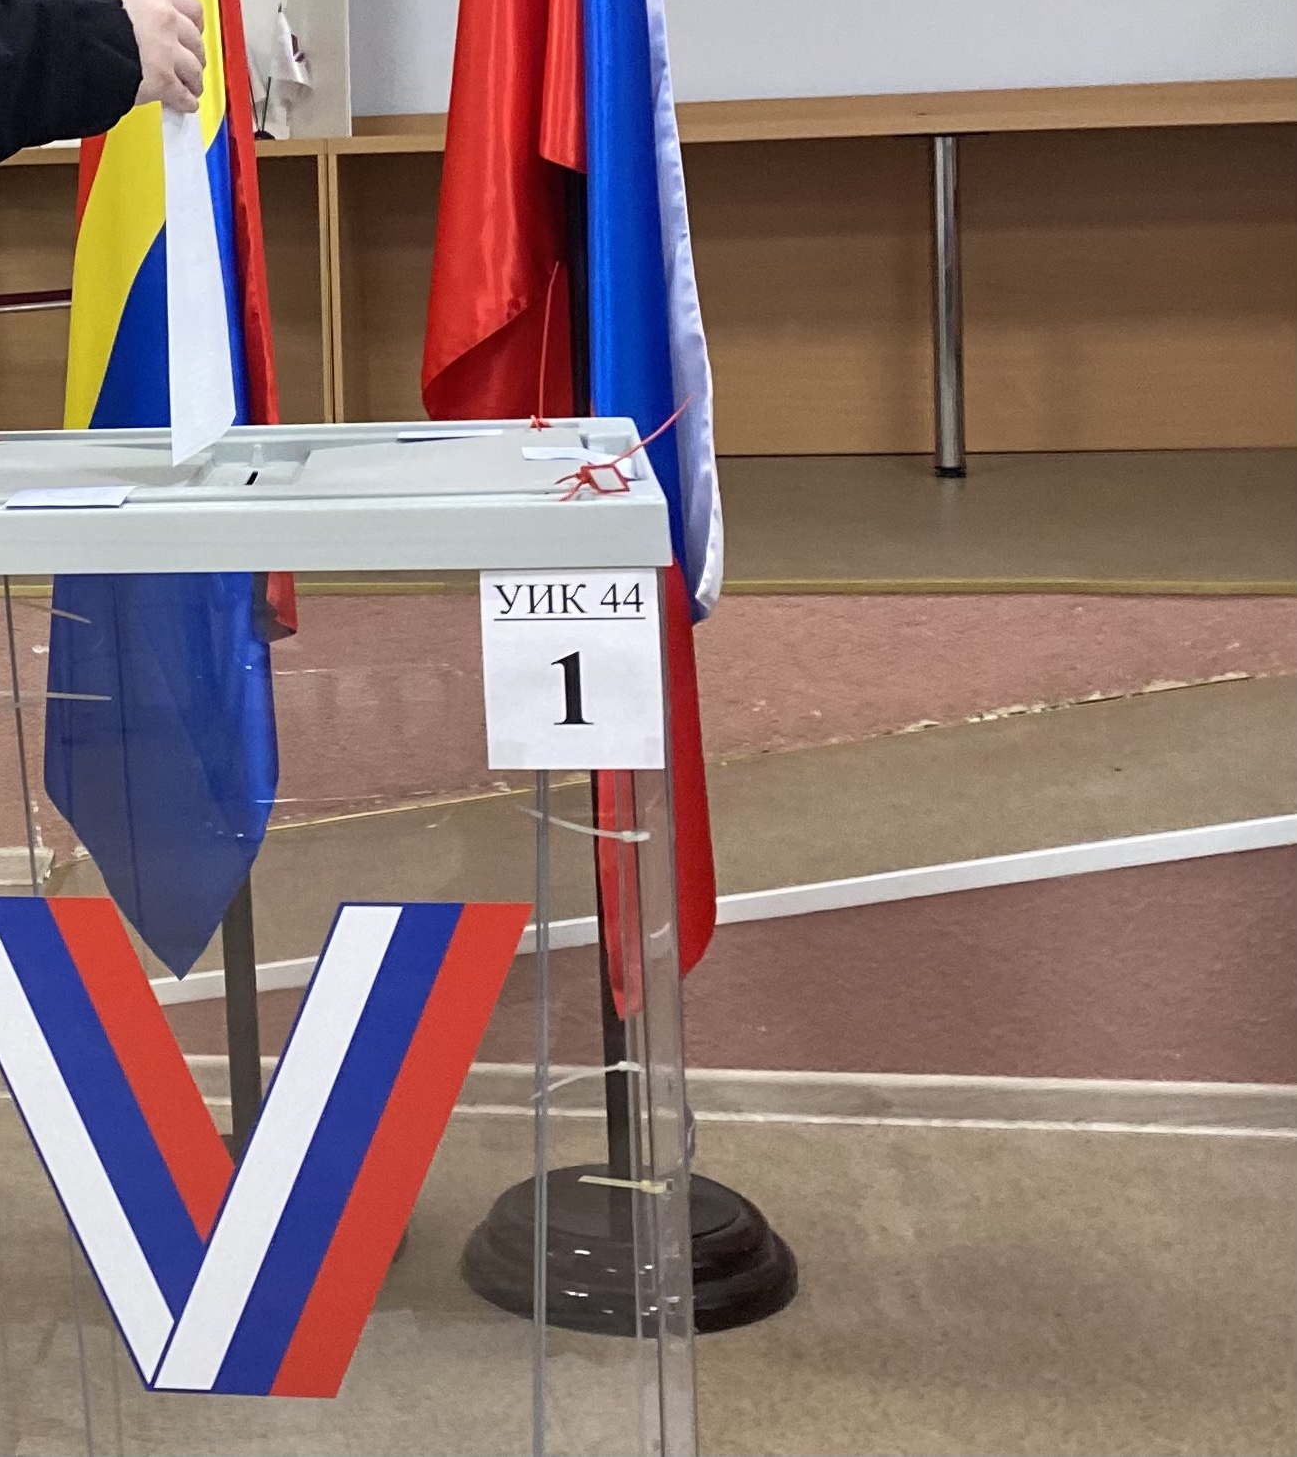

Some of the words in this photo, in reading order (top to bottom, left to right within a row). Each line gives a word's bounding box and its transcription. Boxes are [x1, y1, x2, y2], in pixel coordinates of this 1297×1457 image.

[493, 583, 588, 614] УИК
[600, 582, 644, 613] 44
[551, 651, 595, 726] 1
